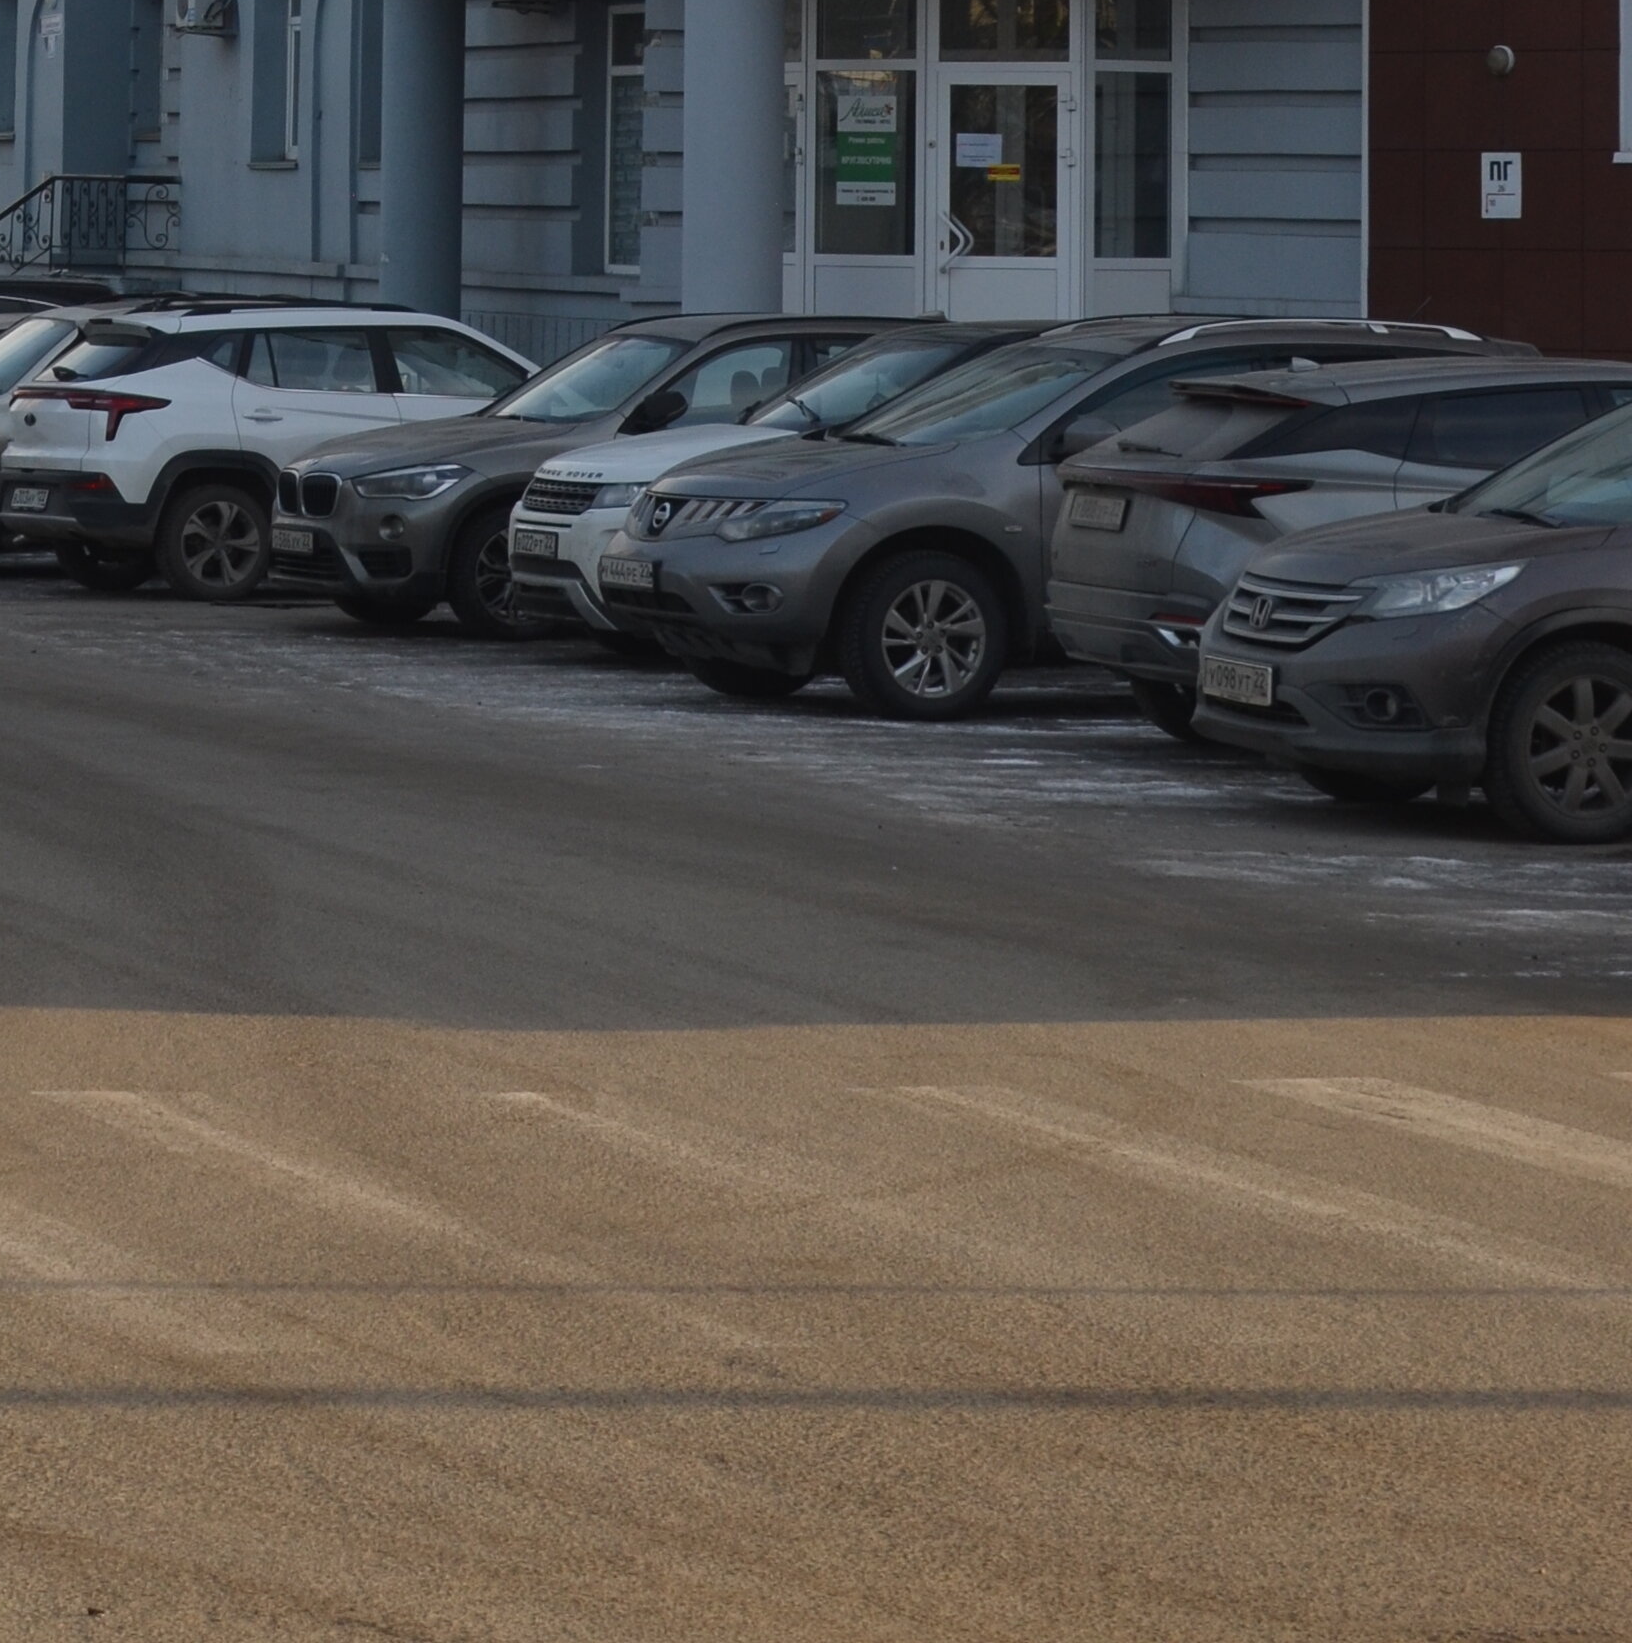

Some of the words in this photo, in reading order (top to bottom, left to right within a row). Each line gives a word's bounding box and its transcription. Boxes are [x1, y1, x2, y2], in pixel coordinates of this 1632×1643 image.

[1490, 161, 1513, 181] ПГ
[537, 467, 563, 476] RANGE
[544, 535, 554, 549] 22
[639, 563, 650, 578] 22
[1253, 671, 1266, 689] 22
